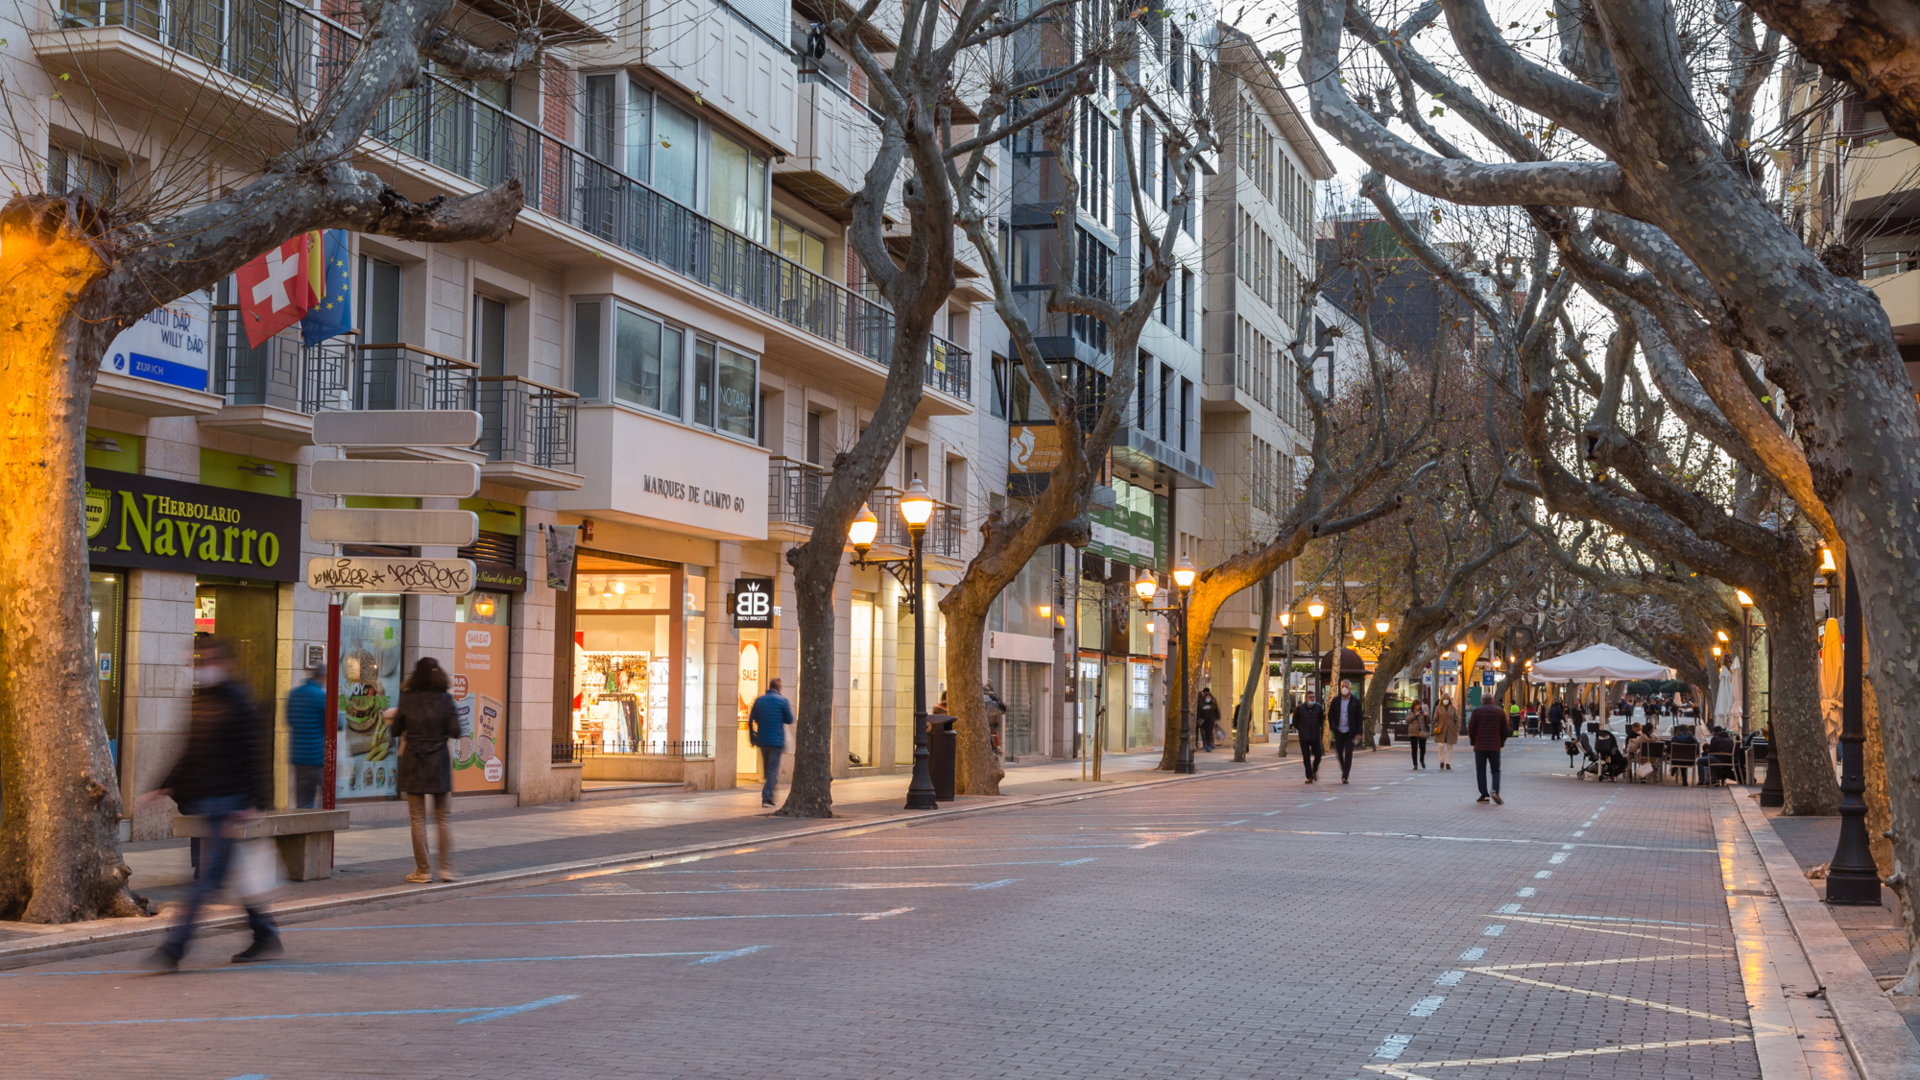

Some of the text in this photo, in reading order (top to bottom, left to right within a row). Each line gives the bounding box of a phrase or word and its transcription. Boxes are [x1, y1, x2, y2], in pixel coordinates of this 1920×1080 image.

[161, 329, 204, 354] WILLY BÄR
[719, 385, 752, 413] NOTARIA
[643, 474, 745, 513] MARQUES DE CAMPO 60
[156, 496, 241, 524] HERBOLARIO
[115, 490, 280, 568] Navarro
[467, 633, 489, 644] SMILEAT
[742, 669, 757, 681] SALE
